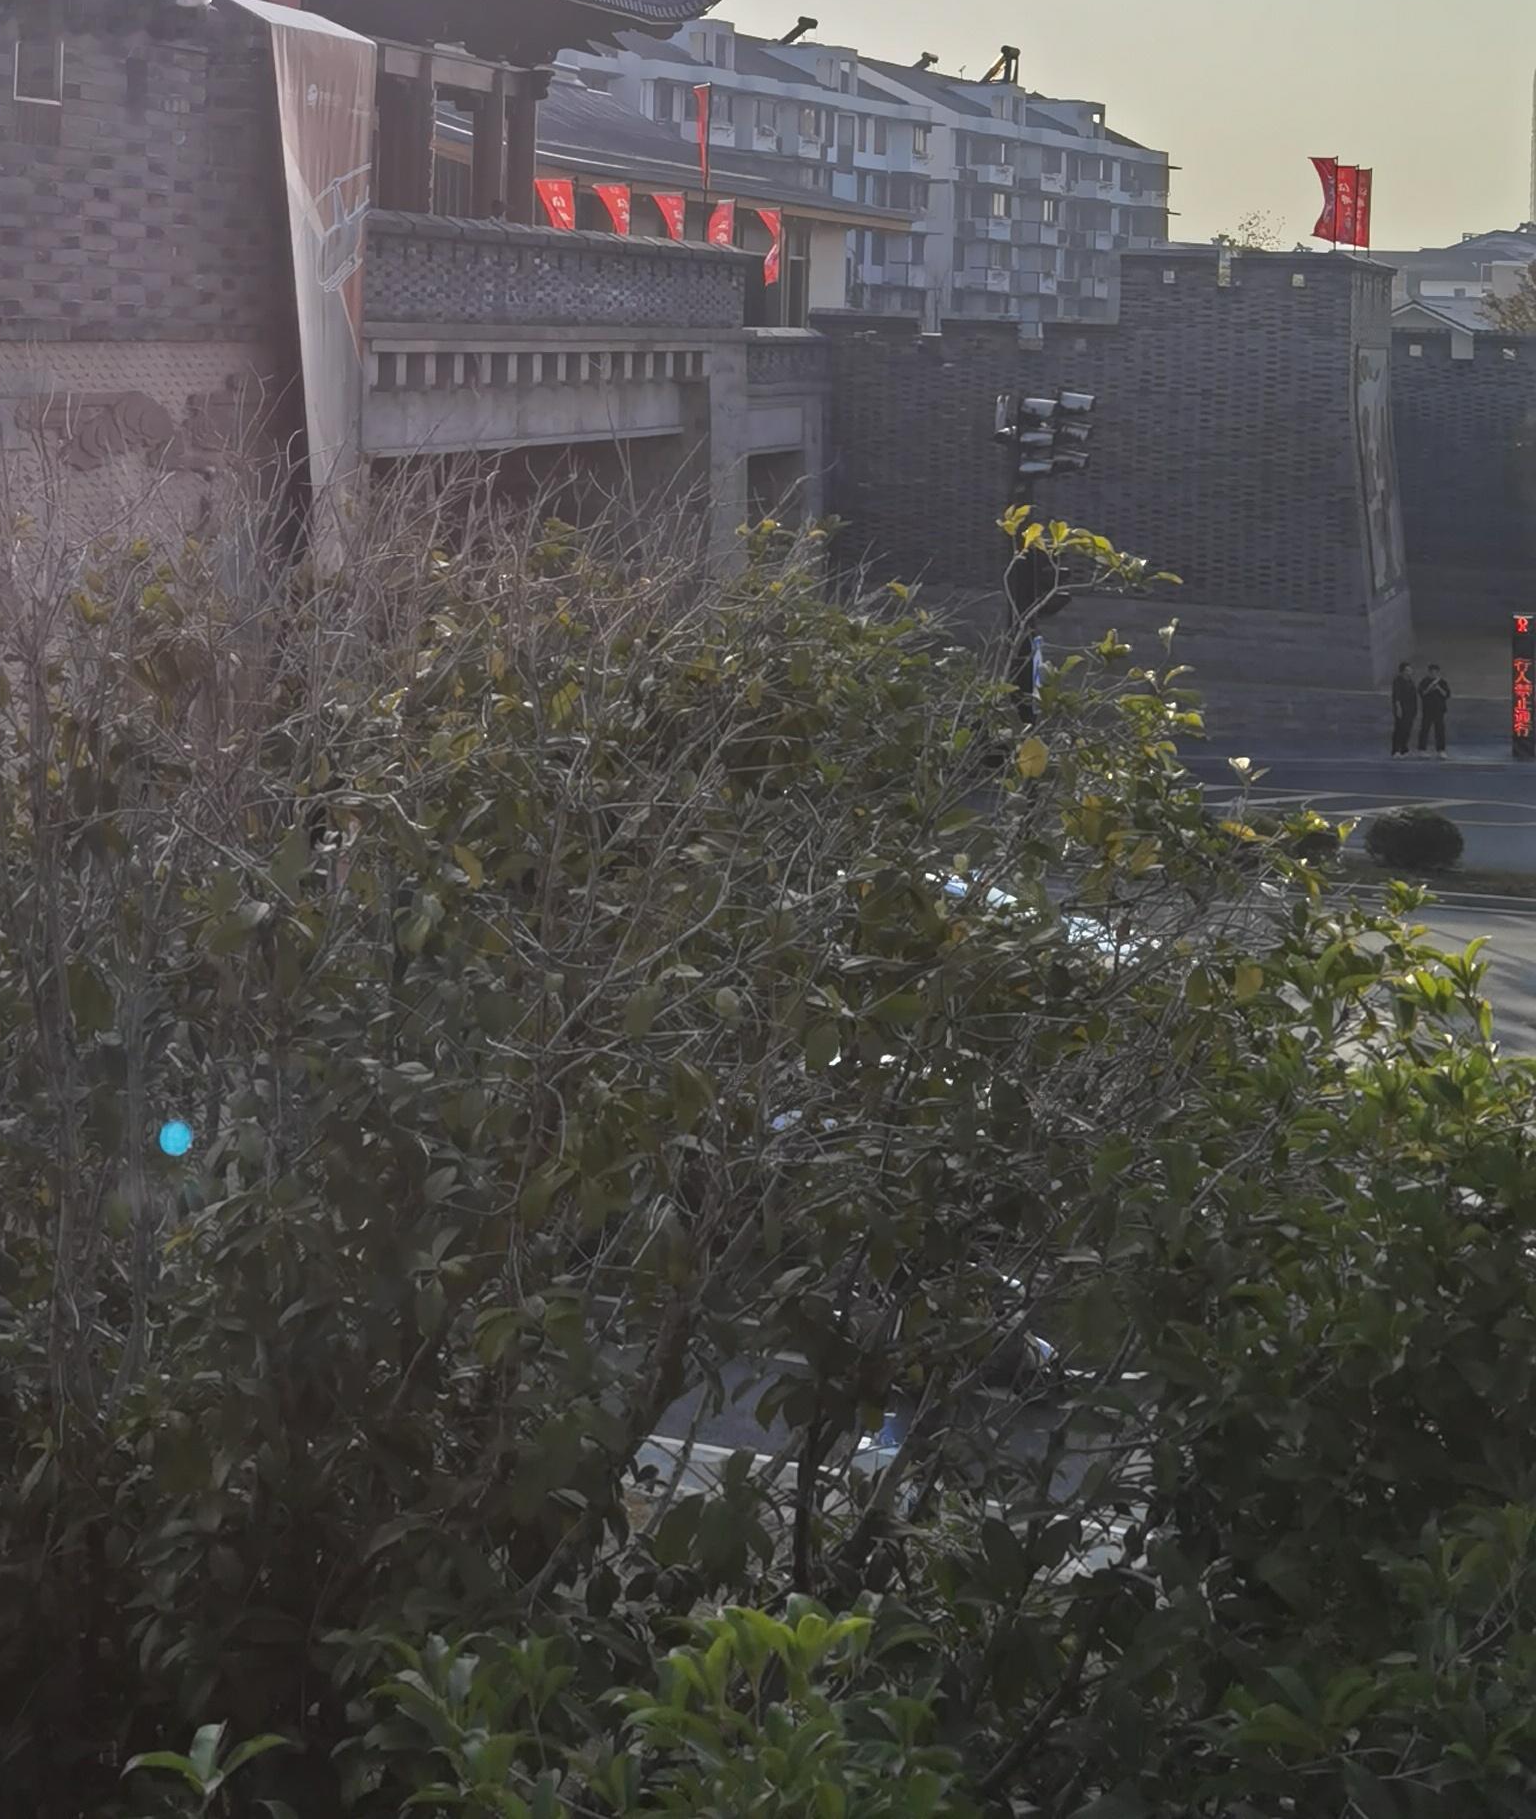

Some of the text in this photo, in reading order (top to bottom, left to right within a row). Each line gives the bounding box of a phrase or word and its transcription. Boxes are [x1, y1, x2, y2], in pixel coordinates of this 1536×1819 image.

[1514, 659, 1532, 737] 行人禁止通行
